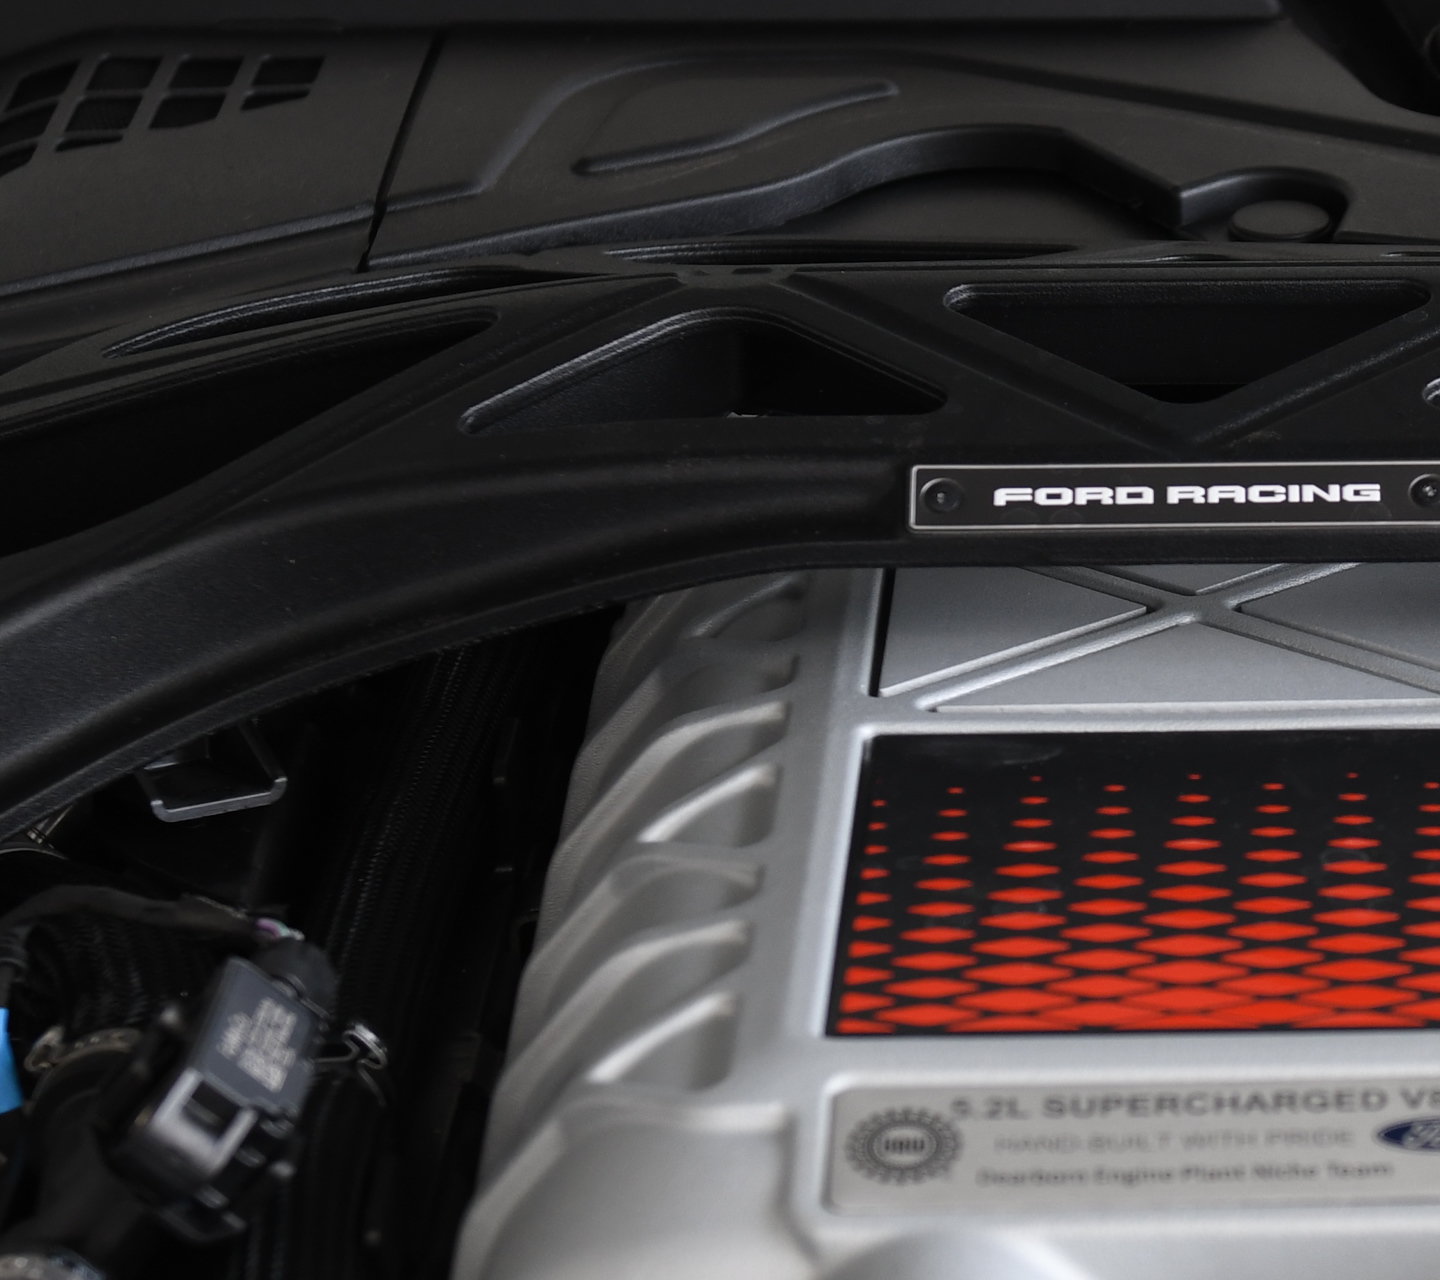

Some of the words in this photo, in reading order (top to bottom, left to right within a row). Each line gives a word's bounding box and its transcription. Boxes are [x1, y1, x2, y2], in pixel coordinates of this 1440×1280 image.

[992, 485, 1155, 507] FORD
[1165, 482, 1382, 505] RACING
[1042, 1088, 1390, 1119] SUPERCHARGED
[1094, 1164, 1175, 1188] Engine
[1326, 1158, 1392, 1179] Team
